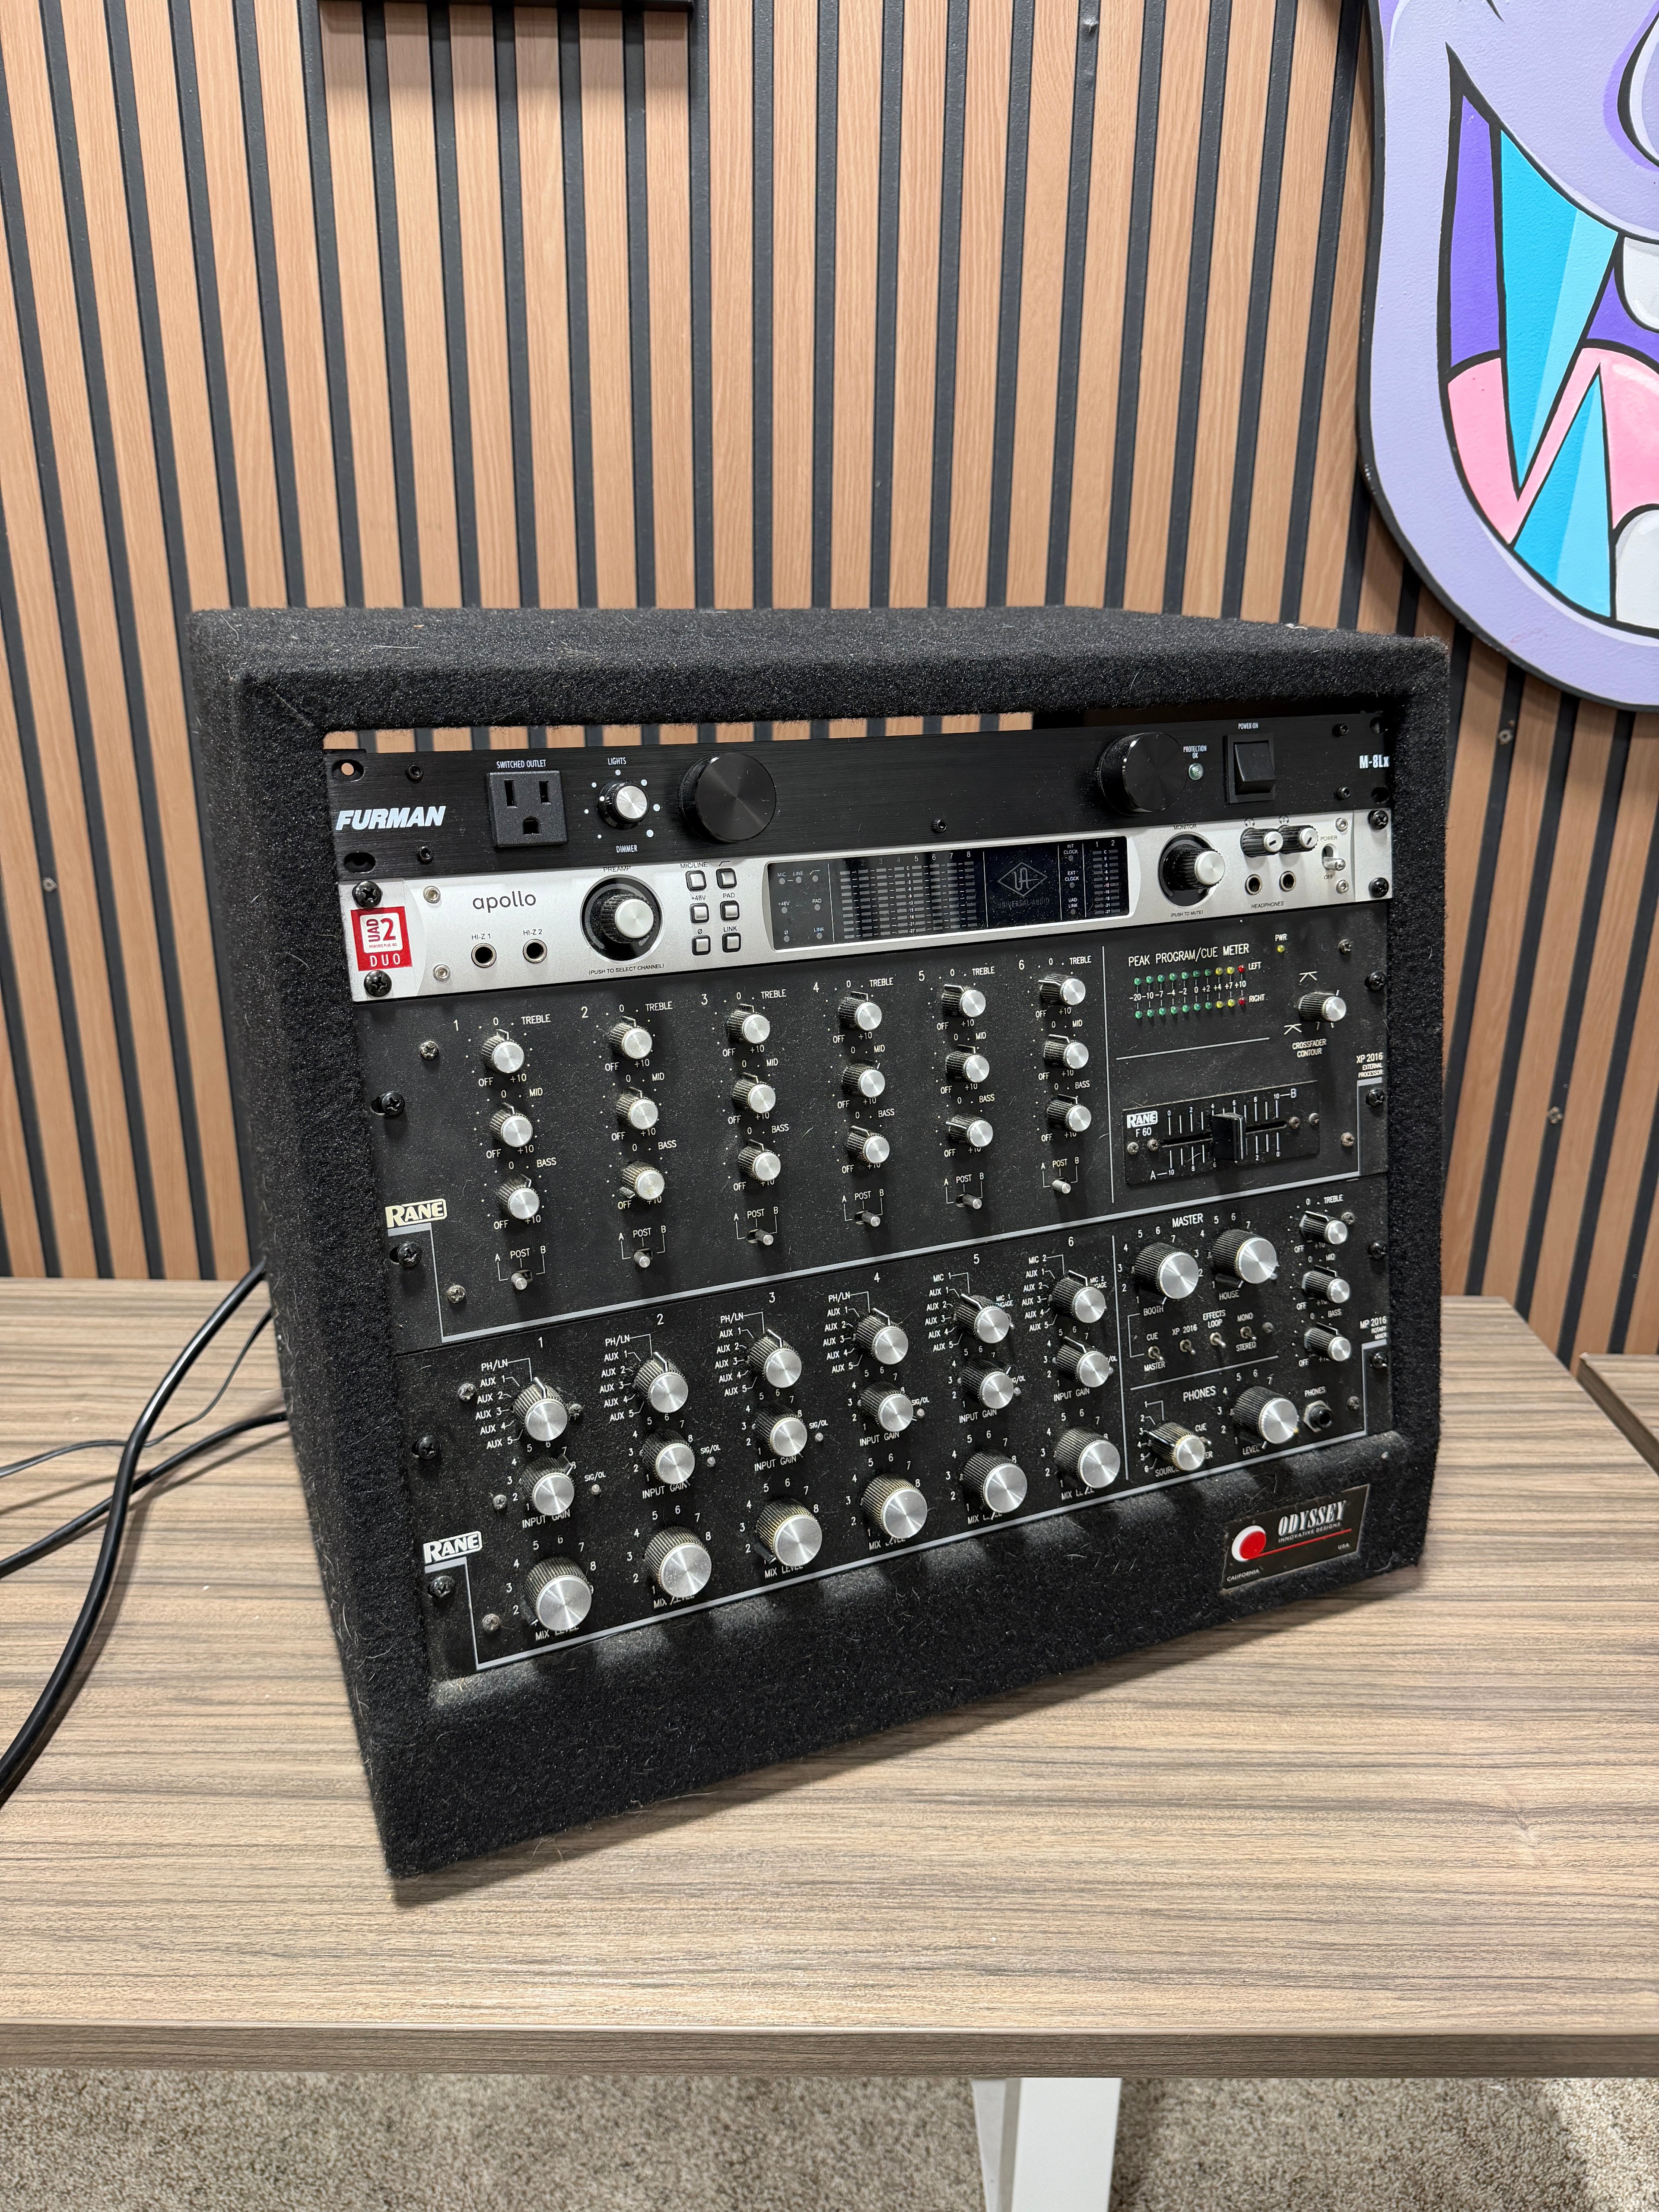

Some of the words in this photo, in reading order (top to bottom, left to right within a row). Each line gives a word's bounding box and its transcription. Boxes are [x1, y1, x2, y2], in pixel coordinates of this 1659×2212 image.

[1360, 755, 1389, 769] M-8Lx
[336, 806, 446, 830] FURMAN
[473, 891, 536, 913] apollo
[366, 919, 380, 942] UAD
[380, 918, 394, 941] 2
[370, 953, 400, 966] DUO
[1129, 955, 1150, 966] PEAK
[1156, 947, 1218, 963] PROGRAM/CUE
[1223, 944, 1249, 956] METER
[1019, 960, 1024, 970] 6
[1069, 956, 1091, 965] TREBLE
[972, 966, 995, 976] TREBLE
[1249, 962, 1261, 970] LEFT
[919, 970, 925, 981] 5
[813, 982, 819, 992] 4
[869, 978, 893, 987] TREBLE
[761, 989, 786, 999] TREBLE
[1249, 994, 1265, 1002] RIGHT
[702, 994, 708, 1005] 3
[645, 1001, 673, 1011] TREBLE
[581, 1007, 588, 1018] 2
[521, 1014, 551, 1024] TREBLE
[454, 1020, 458, 1031] 1
[874, 1045, 885, 1053] MID
[1292, 1039, 1326, 1049] CROSSFADER
[1297, 1048, 1322, 1058] CONTOUR
[1357, 1055, 1365, 1063] XP
[1367, 1052, 1383, 1062] 2016
[652, 1072, 664, 1081] MID
[1358, 1069, 1384, 1078] PROCESSOR
[1075, 1081, 1090, 1089] BASS
[530, 1088, 543, 1096] MID
[1291, 1089, 1296, 1098] B
[979, 1094, 995, 1103] BASS
[878, 1109, 894, 1117] BASS
[1127, 1111, 1157, 1128] RANE
[772, 1124, 789, 1133] BASS
[1136, 1128, 1140, 1137] F
[1143, 1127, 1151, 1136] 60
[658, 1140, 677, 1149] BASS
[537, 1157, 556, 1167] BASS
[1052, 1159, 1067, 1168] POST
[1150, 1170, 1156, 1180] A
[1324, 1194, 1343, 1204] TREBLE
[385, 1199, 447, 1228] RANE
[747, 1209, 764, 1218] POST
[1173, 1213, 1203, 1227] MASTER
[633, 1228, 651, 1238] POST
[510, 1248, 530, 1259] POST
[933, 1274, 944, 1282] MIC
[829, 1292, 851, 1303] PH/LN
[1219, 1290, 1239, 1300] HOUSE
[1144, 1306, 1163, 1316] BOOTH
[1203, 1309, 1225, 1320] EFFECTS
[1328, 1309, 1341, 1317] BASS
[721, 1312, 744, 1324] PH/LN
[1237, 1313, 1253, 1322] MONO
[1360, 1319, 1369, 1329] MP
[1371, 1316, 1386, 1327] 2016
[1183, 1324, 1197, 1333] 2016
[1208, 1319, 1222, 1328] LOOP
[1371, 1325, 1386, 1334] ROTARY
[605, 1335, 629, 1346] PH/LN
[1147, 1332, 1158, 1341] CUE
[1236, 1341, 1256, 1351] STEREO
[481, 1359, 509, 1371] PH/LN
[1144, 1361, 1165, 1371] MASTER
[480, 1377, 496, 1387] AUX
[1183, 1386, 1216, 1402] PHONES
[1305, 1386, 1325, 1397] PHONES
[477, 1393, 493, 1404] AUX
[498, 1391, 503, 1399] 2
[1195, 1423, 1206, 1432] CUE
[1243, 1445, 1259, 1455] LEVEL
[754, 1459, 775, 1471] INPUT
[781, 1456, 796, 1465] GAIN
[585, 1471, 606, 1481] SIG/OL
[1278, 1500, 1347, 1536] ODYSSEY
[1278, 1529, 1314, 1543] INNOVATIVE
[1316, 1522, 1340, 1534] DESIGNS
[423, 1531, 482, 1564] RANE
[1227, 1569, 1259, 1581] CALIFORNIA
